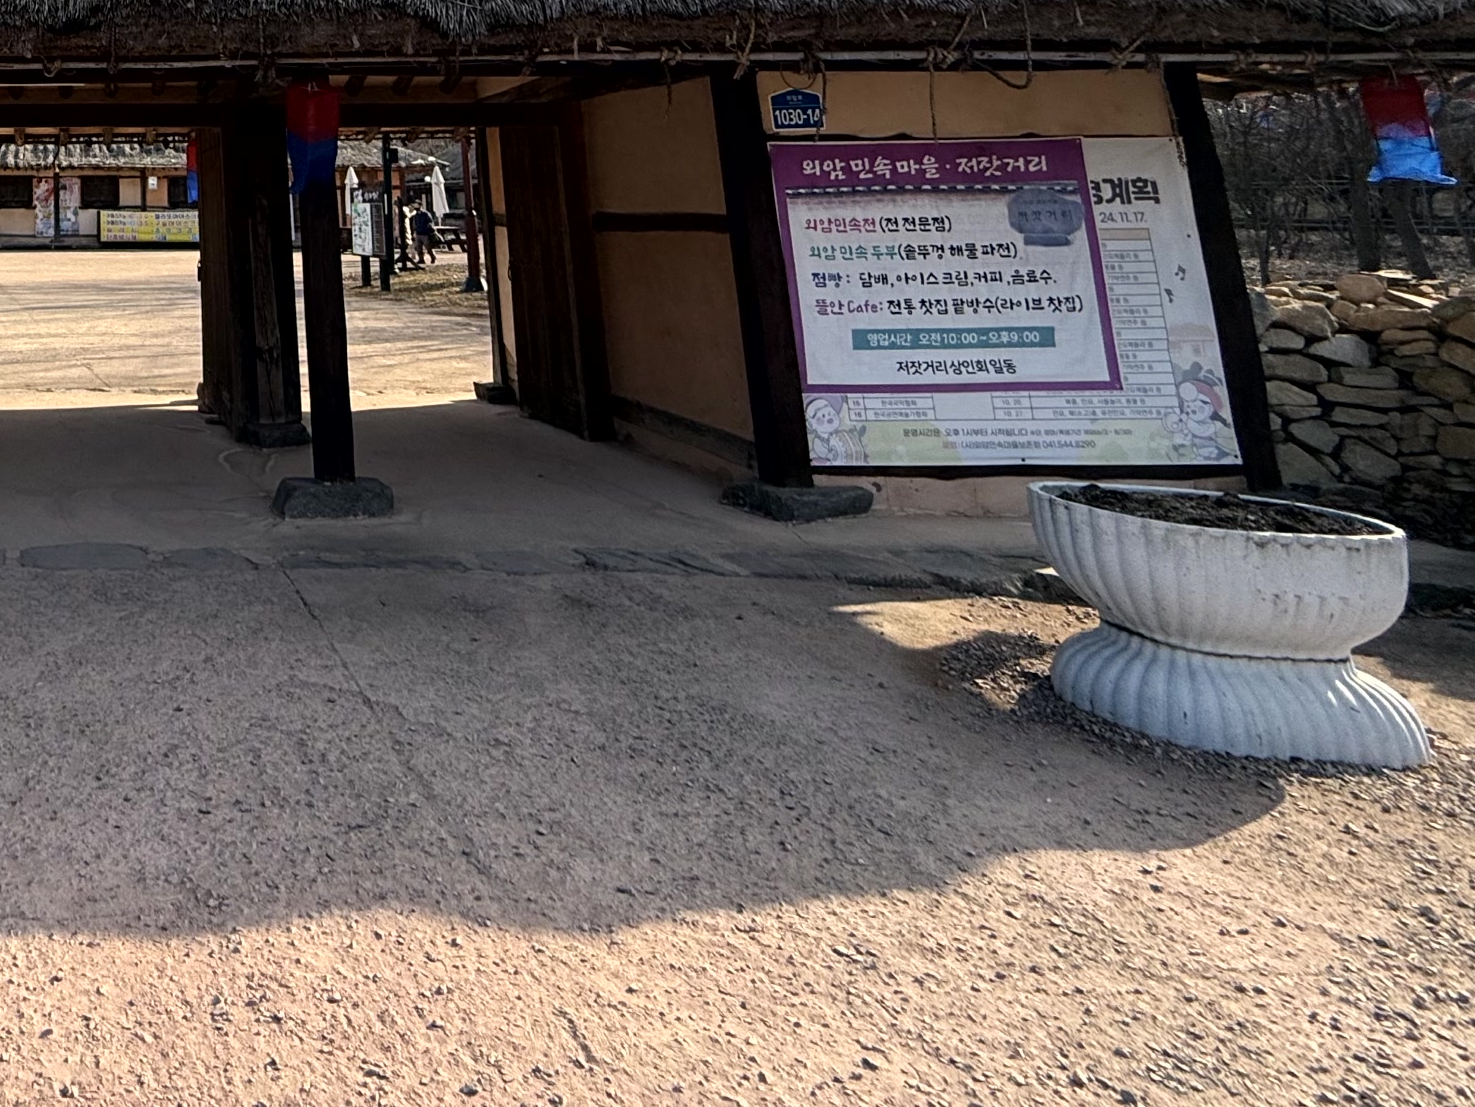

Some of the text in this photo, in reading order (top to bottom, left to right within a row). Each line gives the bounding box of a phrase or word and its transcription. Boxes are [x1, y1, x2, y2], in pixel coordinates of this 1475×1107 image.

[956, 155, 1047, 176] 저잣거리
[805, 217, 876, 233] 외암민속전
[887, 299, 916, 315] 전통
[868, 333, 912, 347] 영업시간
